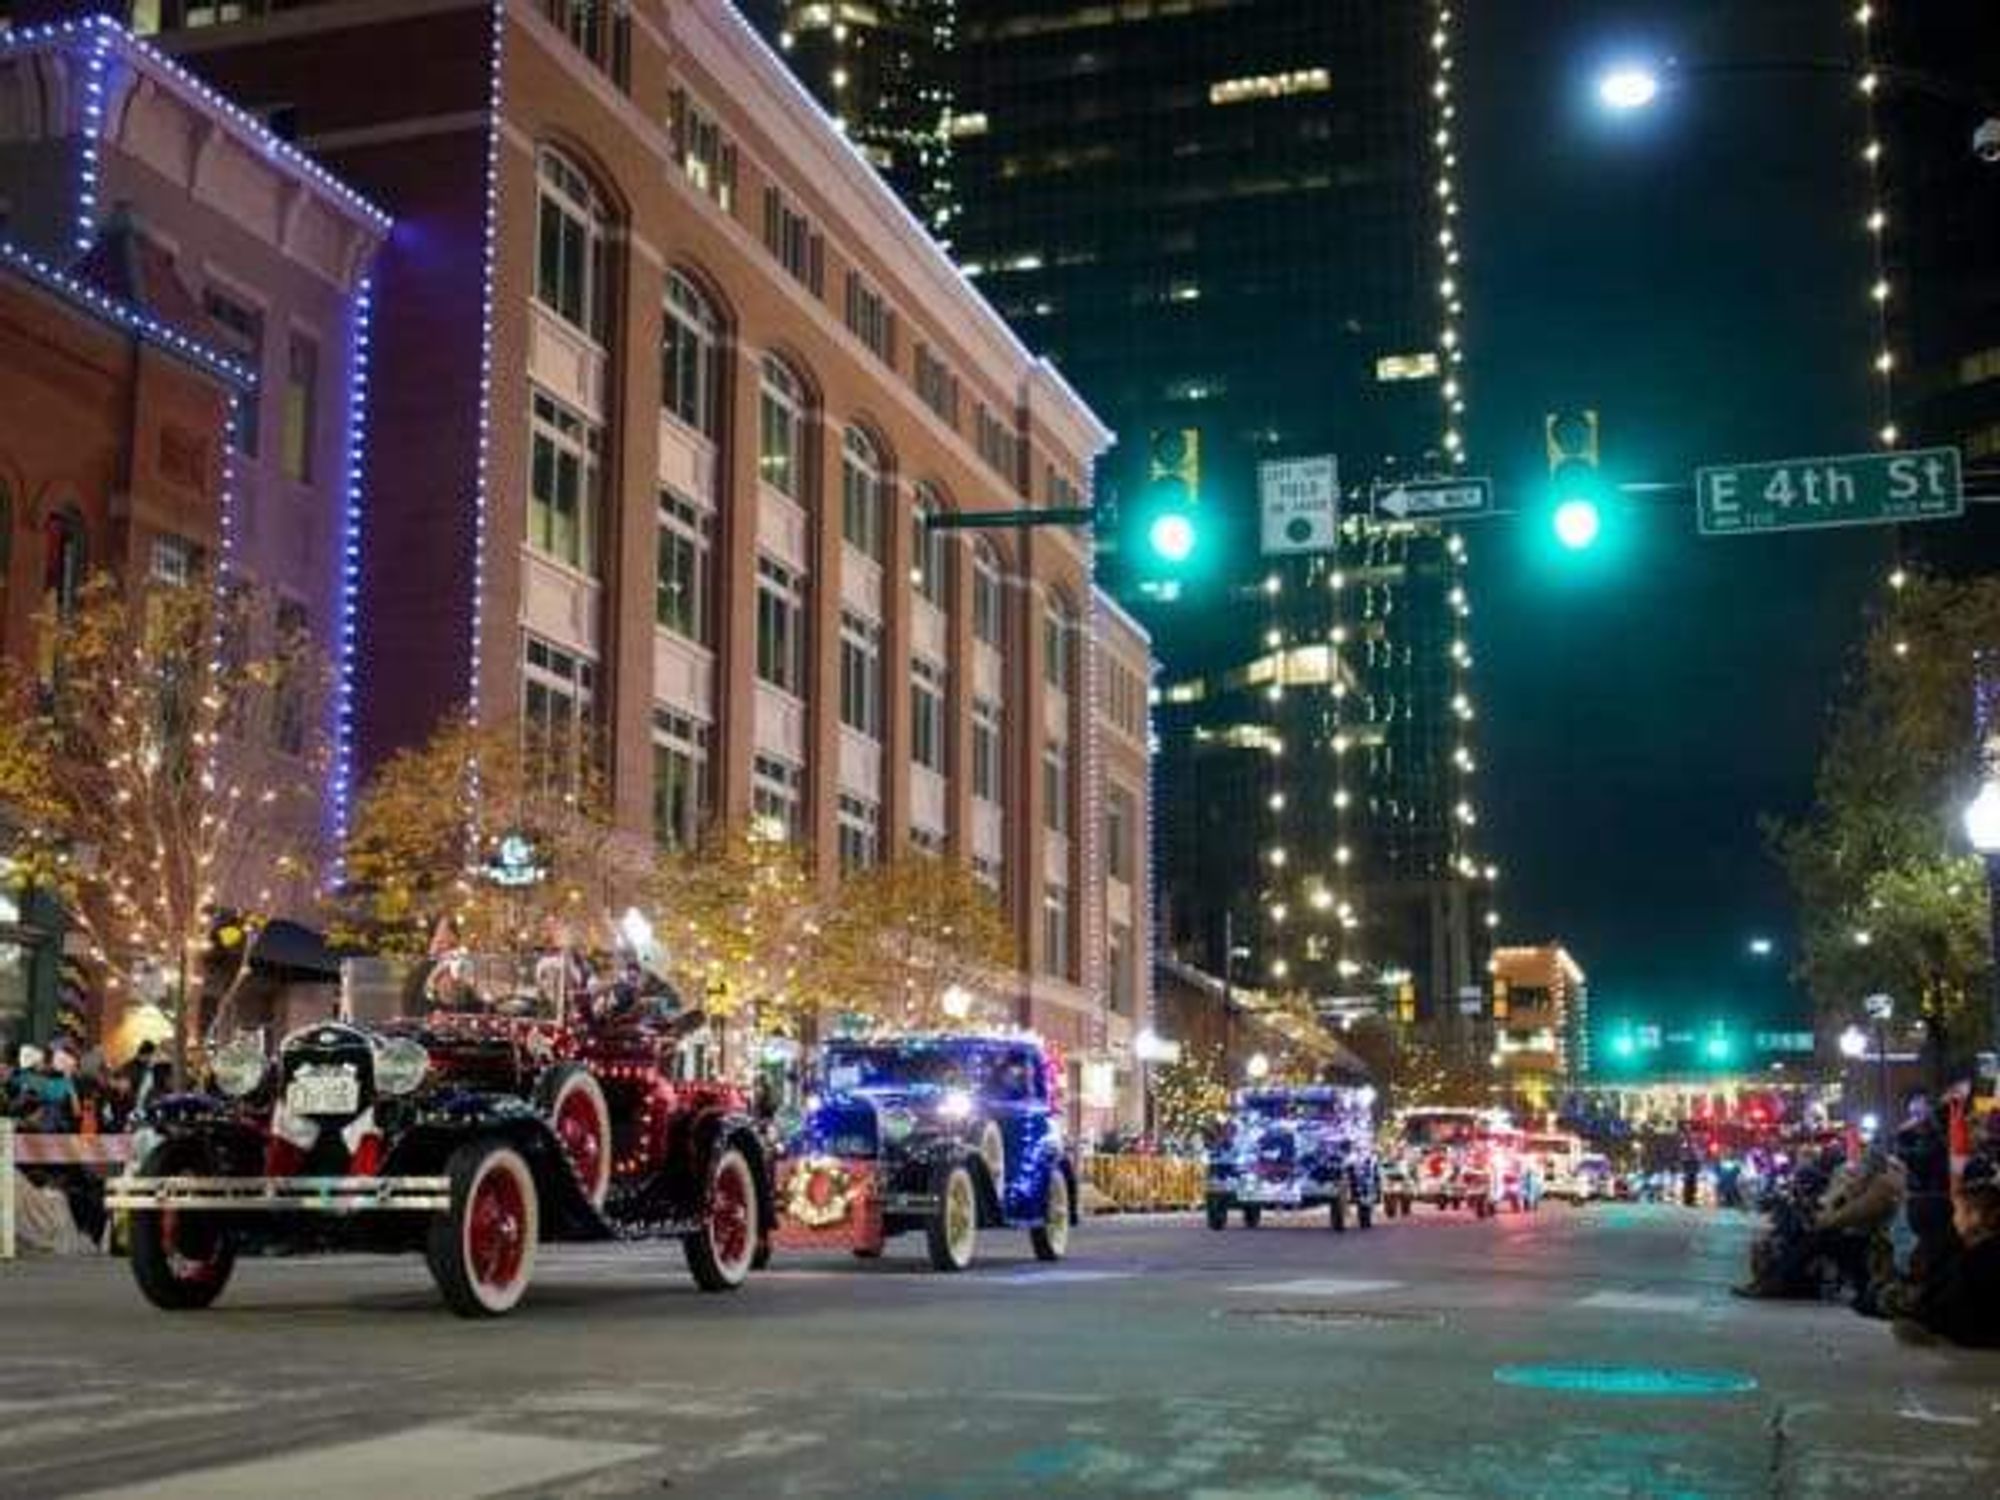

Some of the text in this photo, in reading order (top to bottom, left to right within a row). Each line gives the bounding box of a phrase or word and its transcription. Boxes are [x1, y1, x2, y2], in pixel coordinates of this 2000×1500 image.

[1710, 457, 1945, 512] E 4th St
